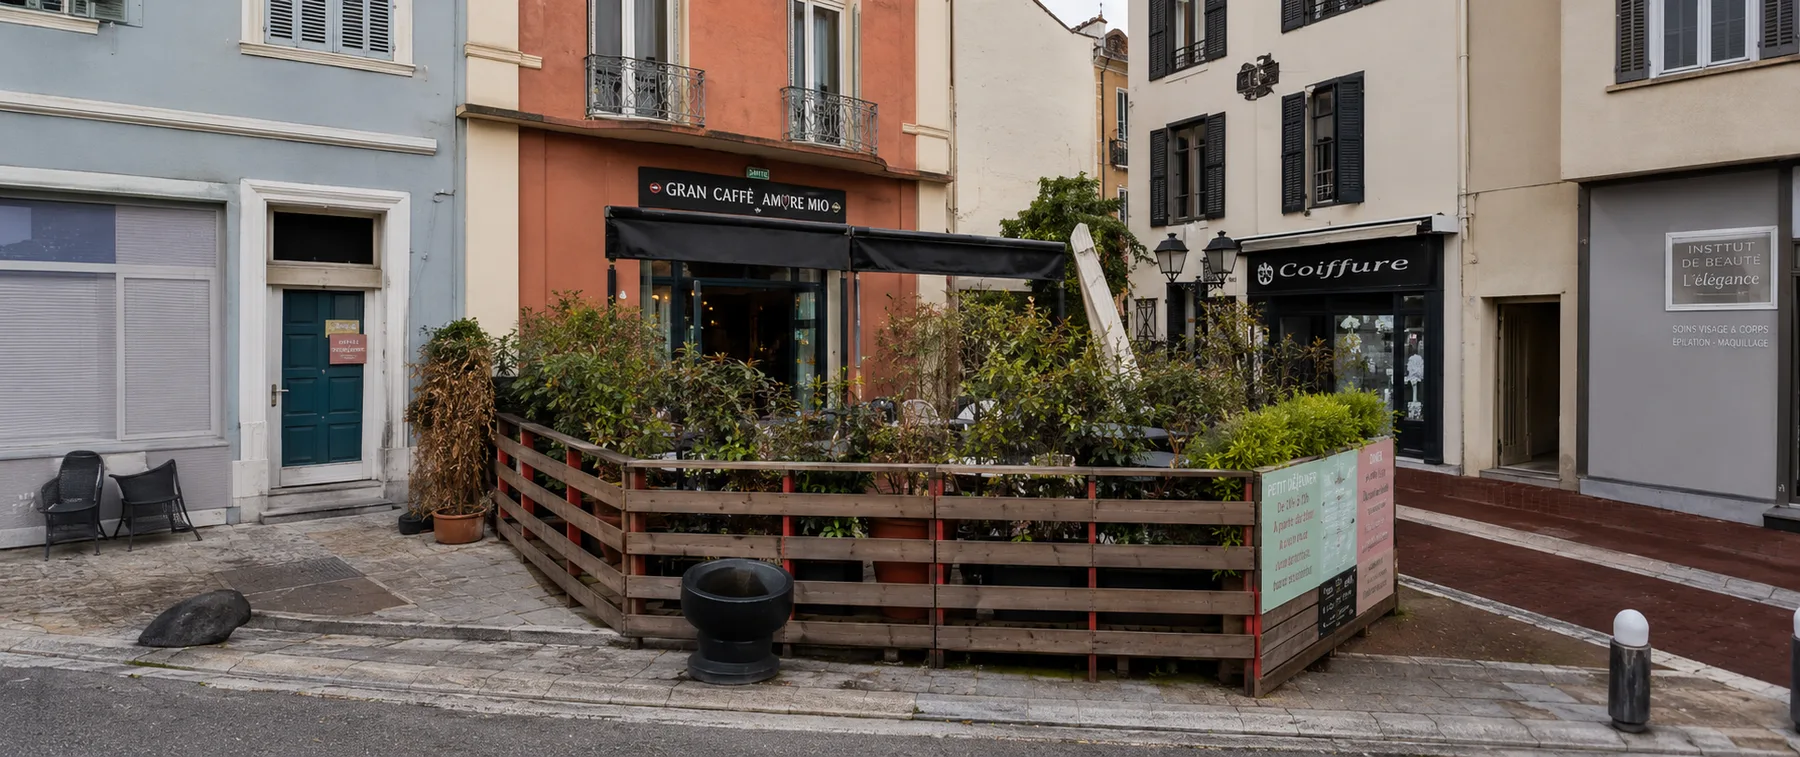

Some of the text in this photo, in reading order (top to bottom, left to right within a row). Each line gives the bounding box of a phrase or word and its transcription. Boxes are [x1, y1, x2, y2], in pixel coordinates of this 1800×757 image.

[666, 182, 707, 199] GRAN
[807, 198, 830, 213] MIO
[1279, 258, 1409, 280] Coiffure
[1682, 258, 1699, 268] DE
[1683, 272, 1760, 290] L'élégance
[1672, 324, 1697, 334] SOINS
[1699, 324, 1728, 334] VISAGE
[1739, 324, 1769, 334] CORPS
[1717, 338, 1769, 349] MAQUILLAGE
